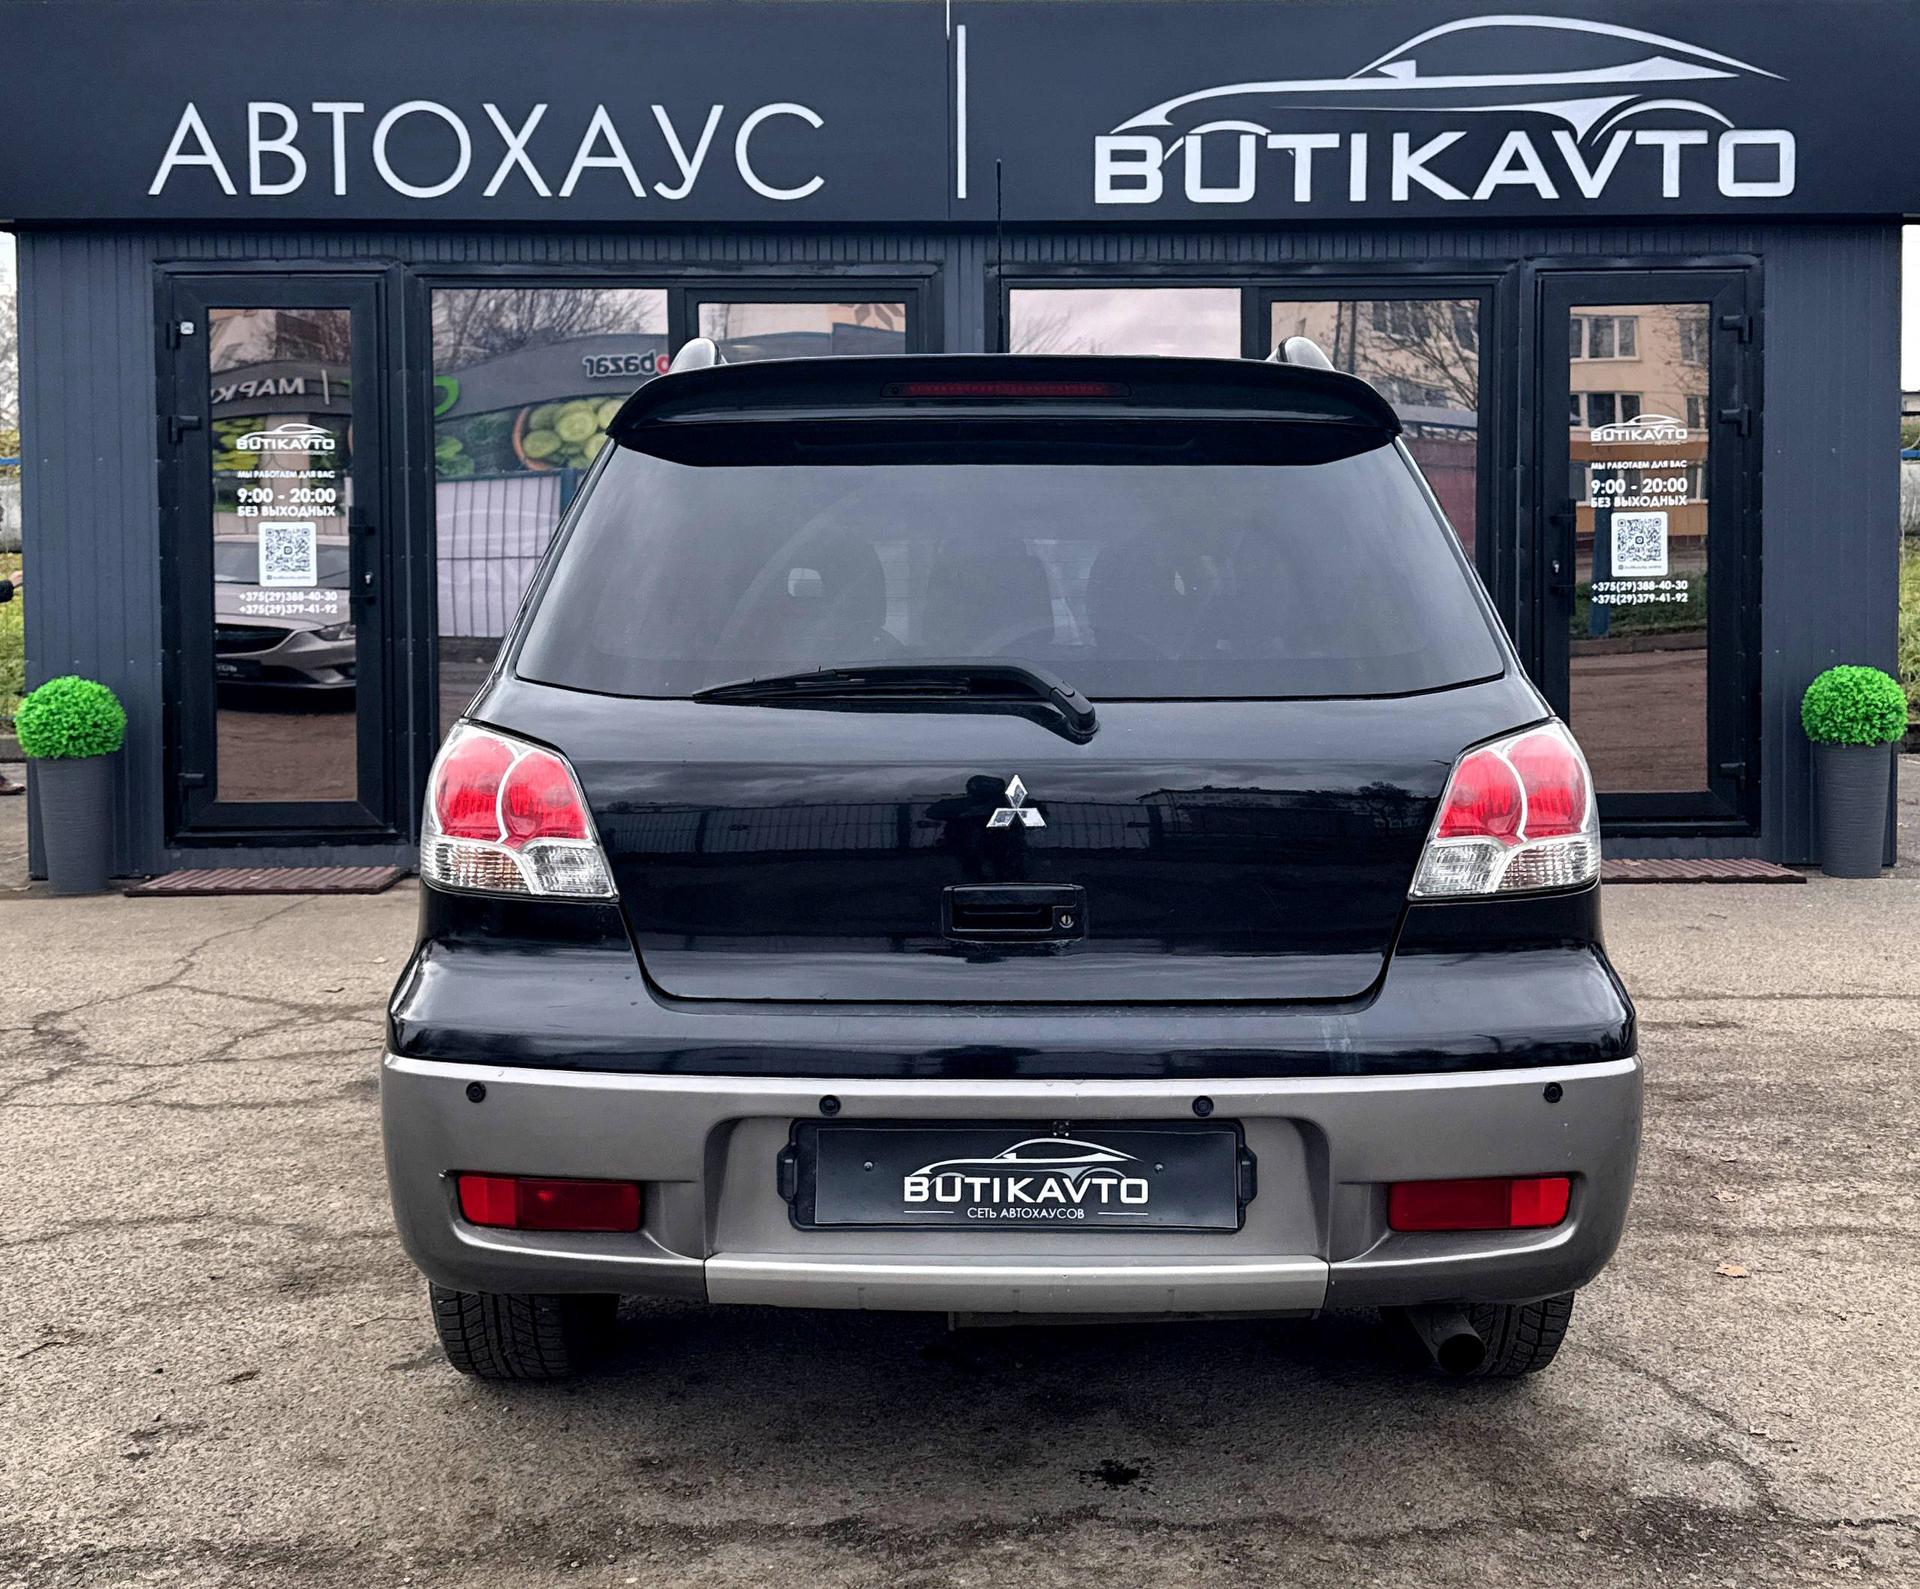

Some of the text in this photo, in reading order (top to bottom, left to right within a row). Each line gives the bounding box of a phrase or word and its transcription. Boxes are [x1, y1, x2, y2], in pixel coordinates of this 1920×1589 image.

[148, 100, 824, 200] АВТОХАУС
[1095, 129, 1795, 203] BUTIKAVTO
[1590, 428, 1688, 441] BUTIKAVTO
[236, 438, 335, 450] BUTIKAVTO
[1590, 460, 1688, 470] МЫ РАБОТАЕМ ДЛЯ ВАС
[237, 470, 335, 479] МЫ РАБОТАЕМ ДЛЯ ВАС
[1590, 479, 1626, 494] 9:00
[1642, 477, 1688, 493] 20:00
[237, 487, 274, 503] 9:00
[289, 487, 336, 503] 20:00
[1590, 495, 1688, 508] БЕЗ ВЫХОДНЫХ
[237, 505, 336, 518] БЕЗ ВЫХОДНЫХ
[1591, 592, 1688, 605] +375(29)379-41-92
[239, 604, 337, 616] +375(29)379-41-92
[903, 1176, 1149, 1204] BUTIKAVTO
[967, 1207, 1085, 1219] СЕТЬ АВТОХАУСОВ
